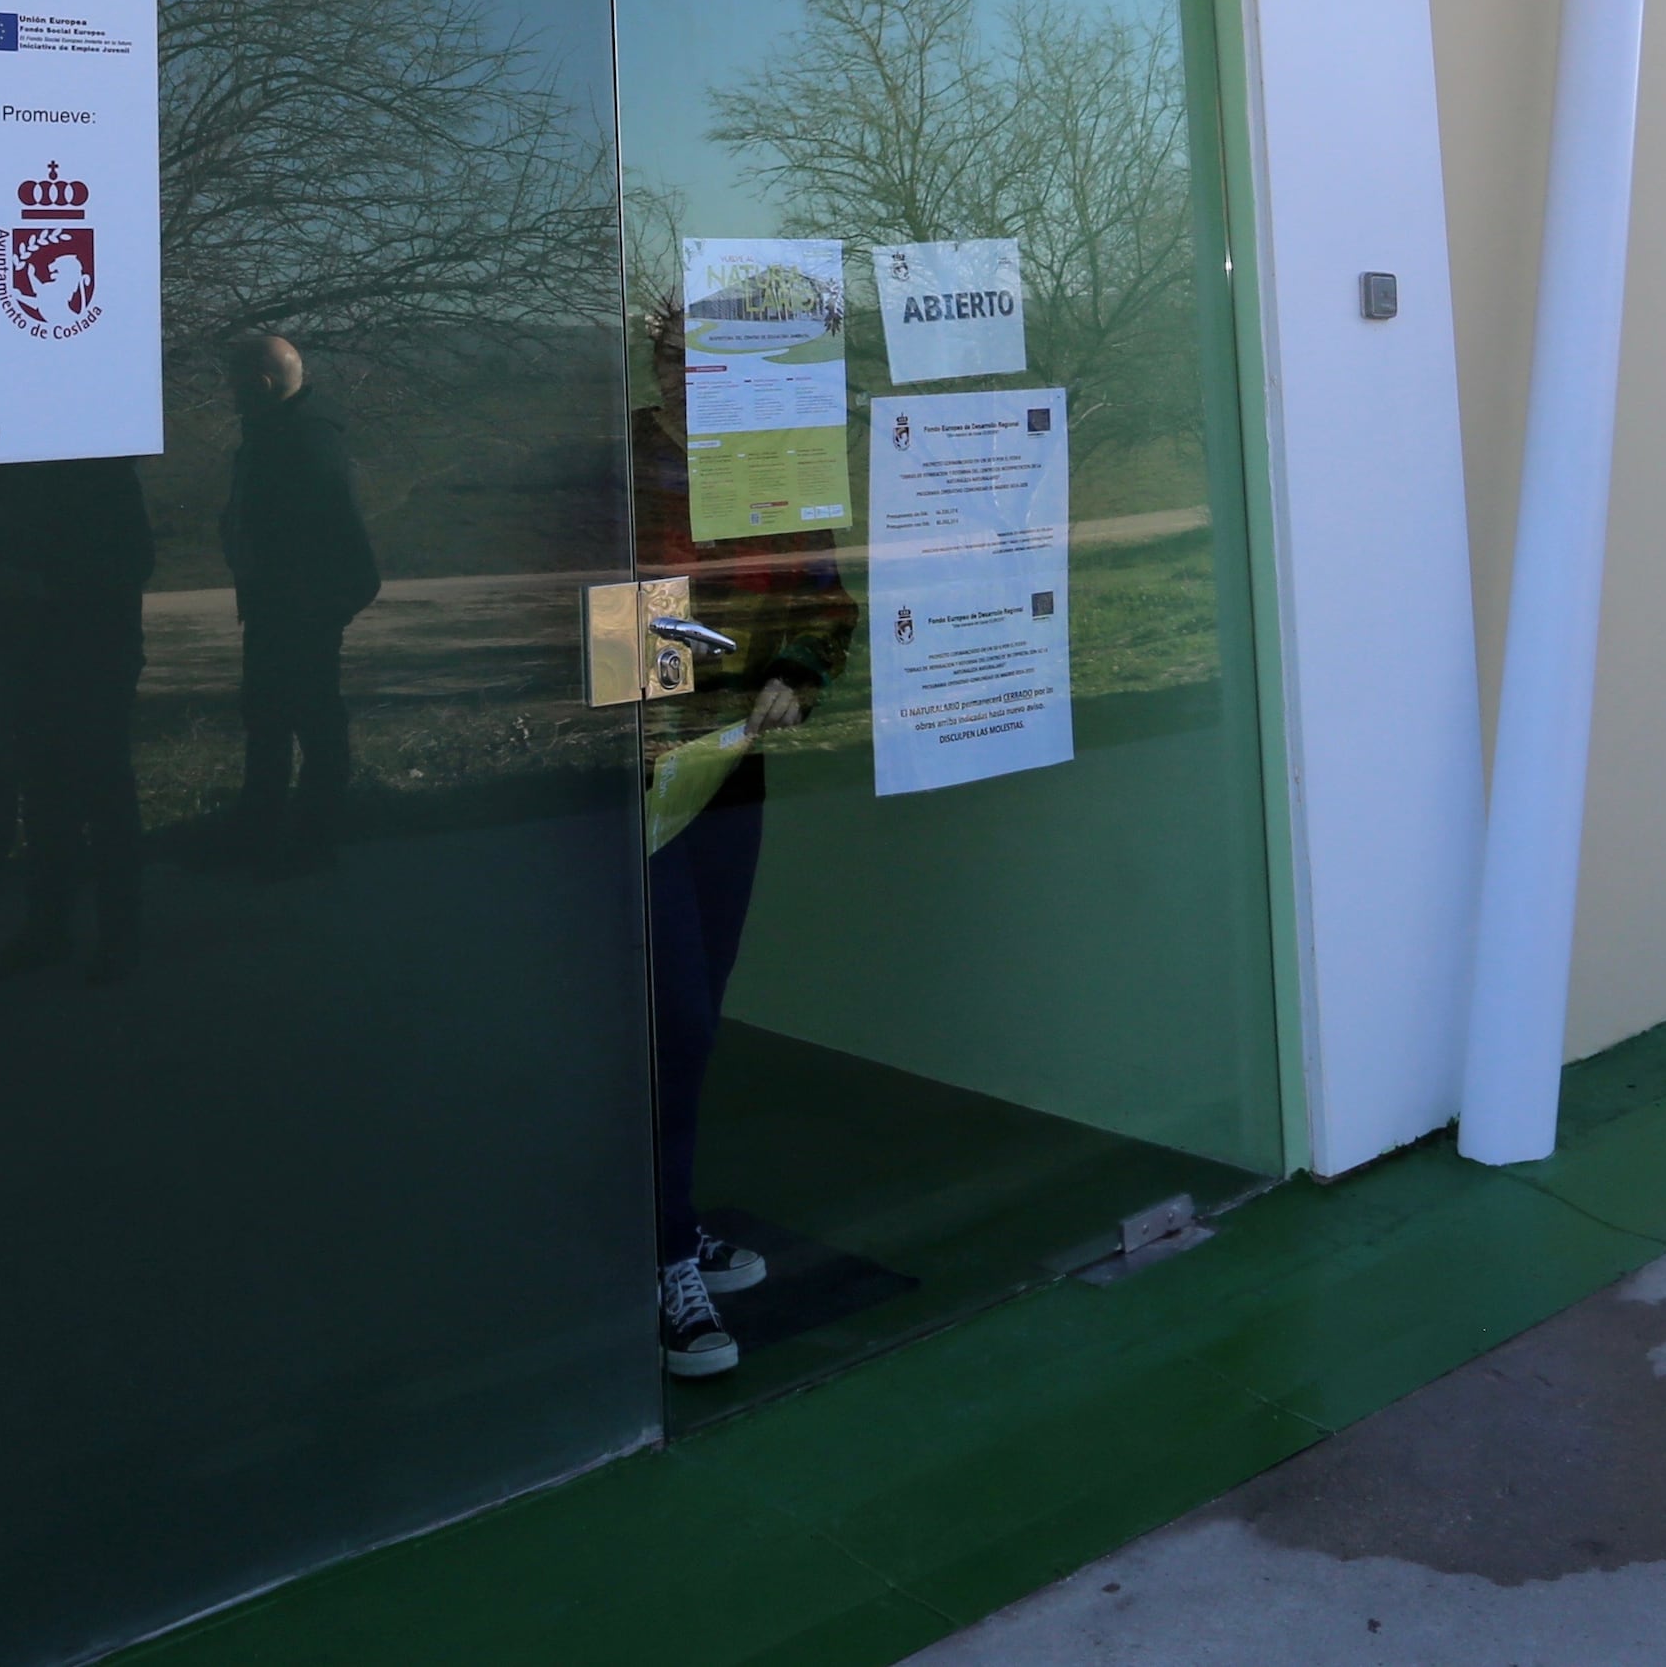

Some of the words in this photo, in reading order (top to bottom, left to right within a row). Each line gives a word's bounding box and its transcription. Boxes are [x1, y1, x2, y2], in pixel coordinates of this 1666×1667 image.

[19, 15, 46, 24] Unión
[49, 17, 87, 26] Europea
[74, 28, 105, 37] Europeo
[3, 105, 96, 123] Promueve:
[903, 290, 1014, 324] ABIERTO
[31, 323, 48, 340] de
[53, 305, 103, 340] Coslada
[909, 701, 960, 717] NATURALARIO
[1003, 689, 1033, 702] CERRADO
[939, 729, 975, 744] DISCULPEN
[976, 726, 989, 738] LAS
